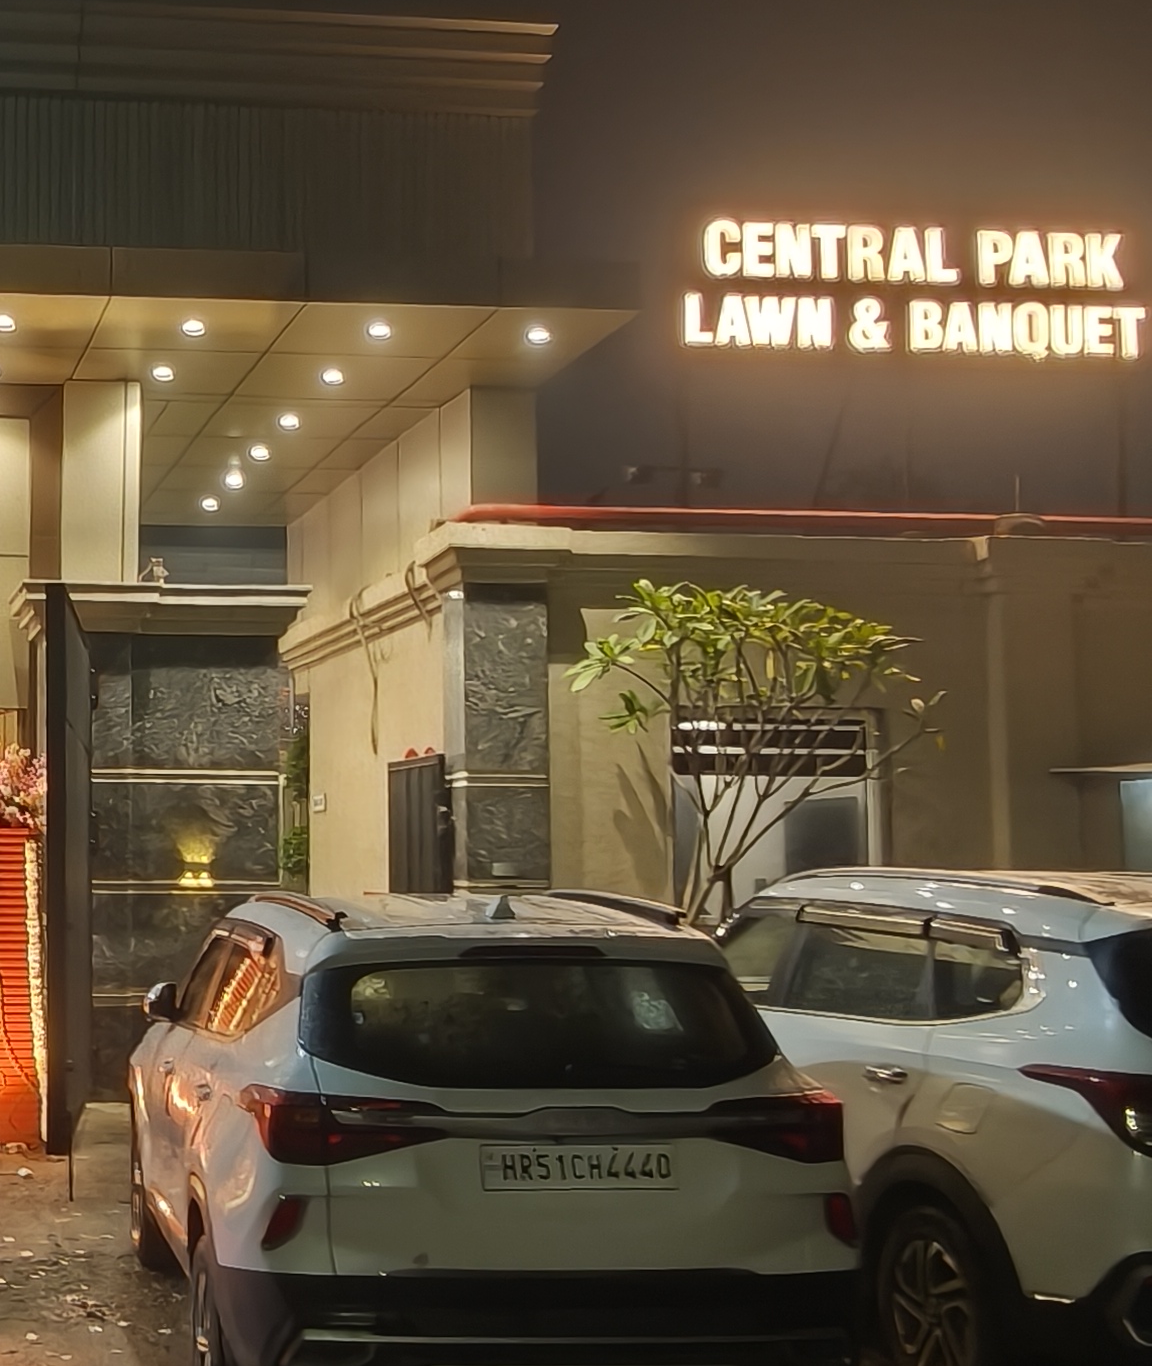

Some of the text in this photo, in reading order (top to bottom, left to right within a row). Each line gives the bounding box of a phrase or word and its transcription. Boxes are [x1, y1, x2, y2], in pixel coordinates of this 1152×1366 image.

[703, 218, 1124, 290] CENTRAL PARK
[682, 291, 1146, 362] LAWN & BANQUET
[501, 1151, 672, 1181] HR51CH4440
